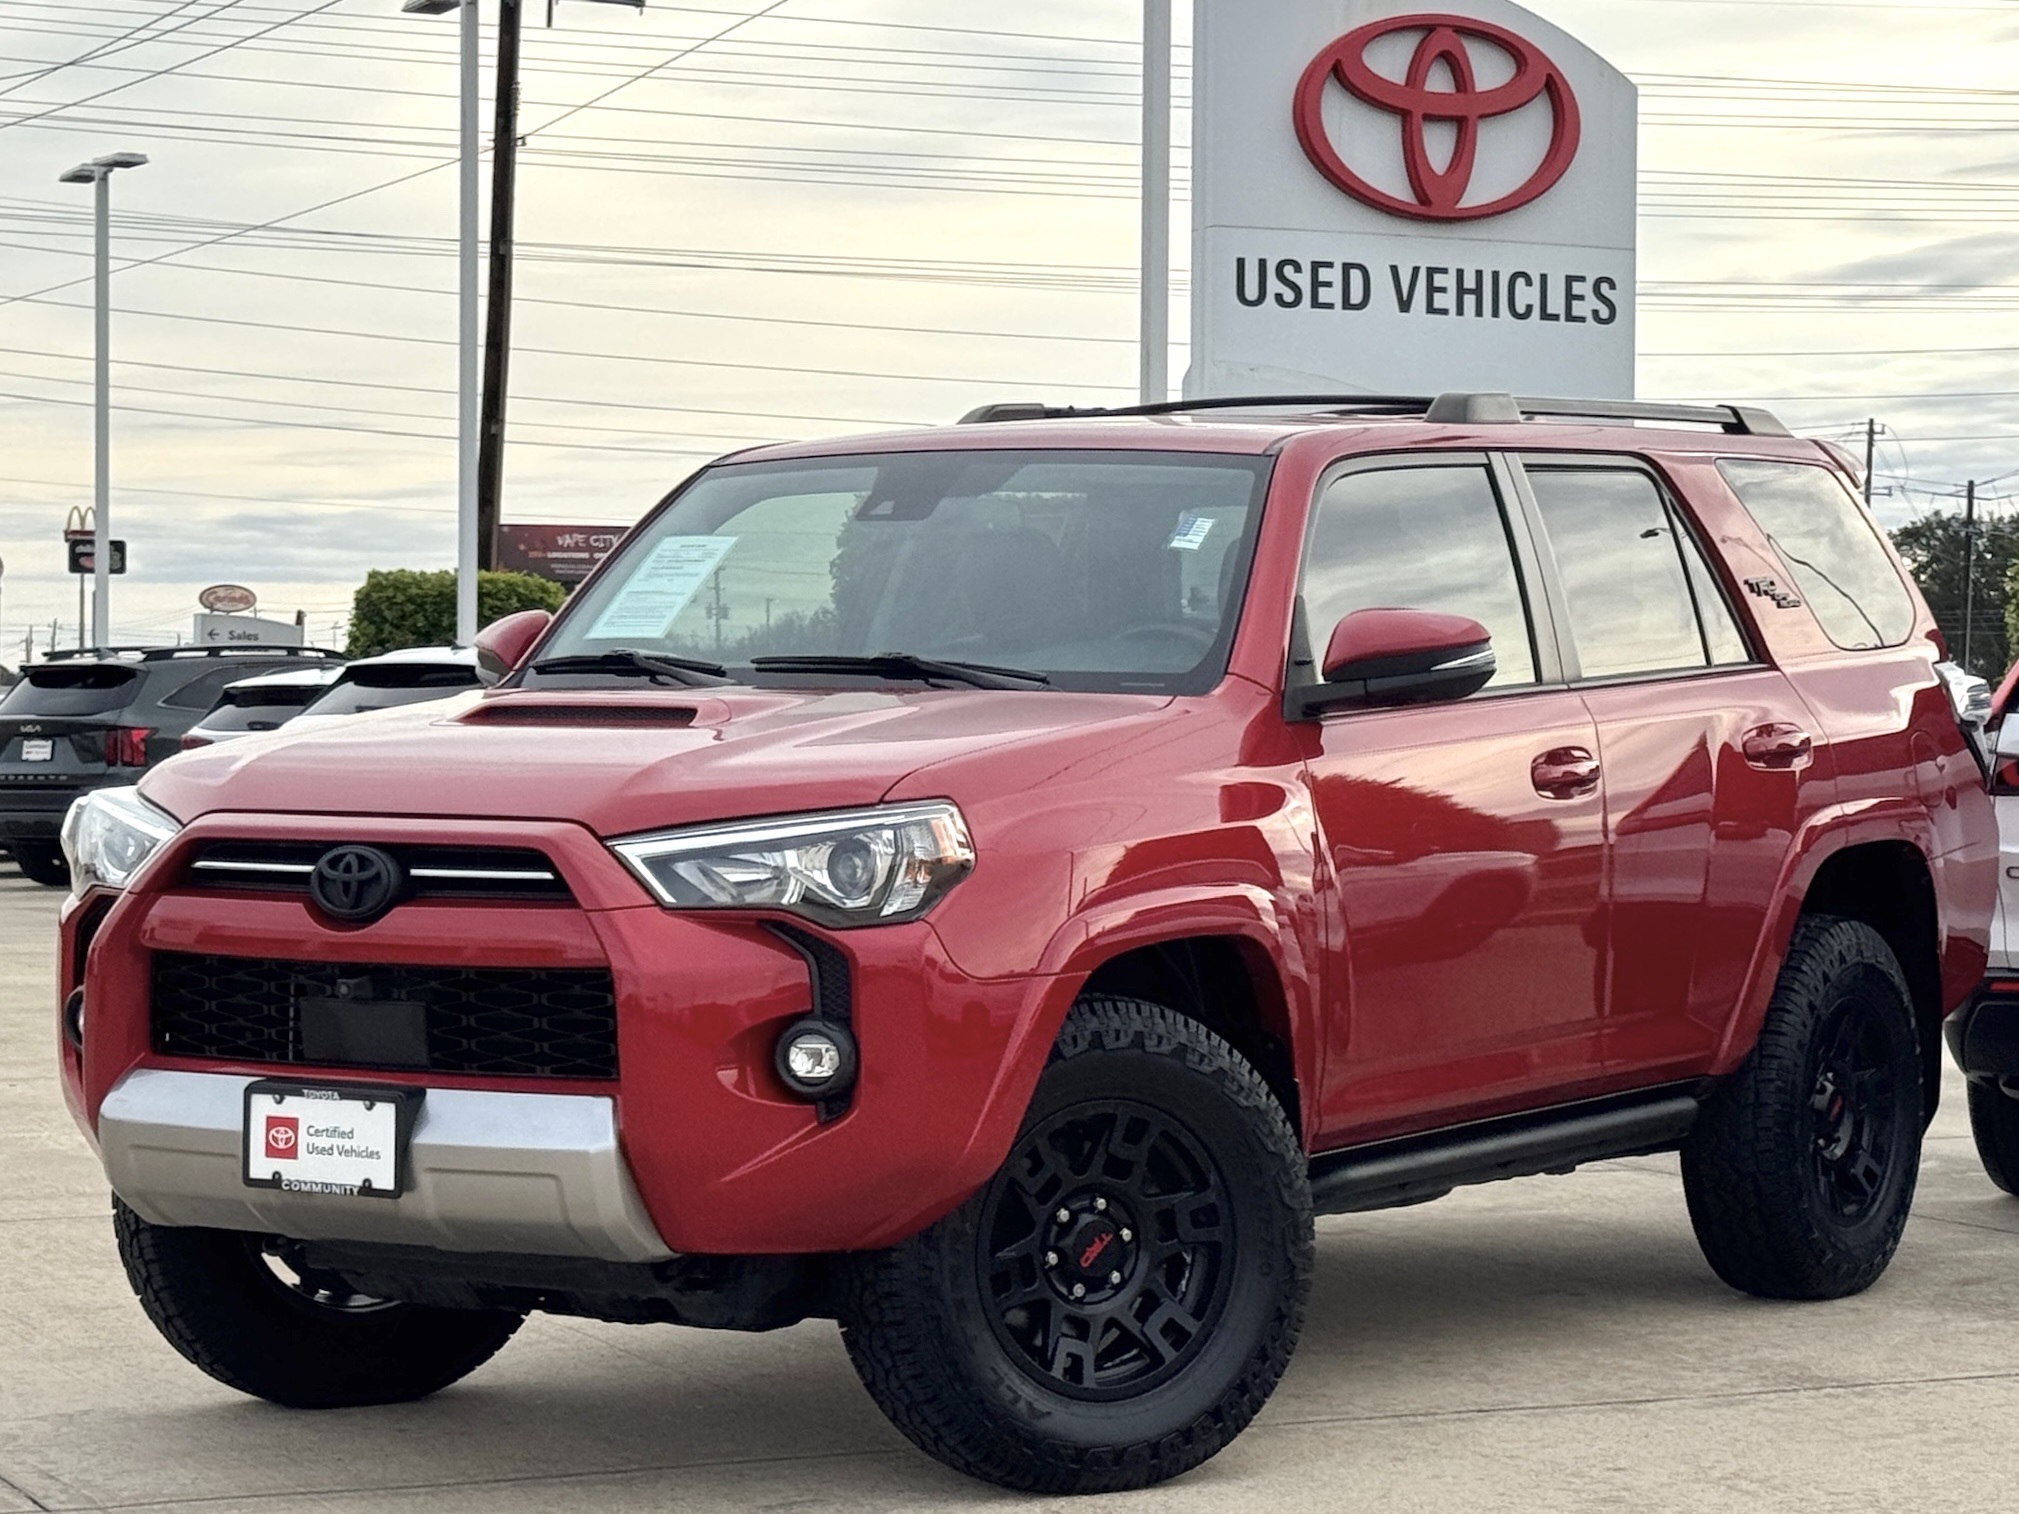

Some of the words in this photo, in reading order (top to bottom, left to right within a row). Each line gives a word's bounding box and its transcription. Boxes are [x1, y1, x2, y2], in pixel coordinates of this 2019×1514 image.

[1235, 256, 1372, 311] USED
[1389, 264, 1618, 325] VEHICLES
[556, 532, 588, 548] VAPE
[228, 629, 259, 641] Sales
[302, 1089, 341, 1101] TOYOTA
[306, 1125, 354, 1140] Certified
[306, 1143, 335, 1156] Used
[337, 1144, 381, 1160] Vehicles
[281, 1179, 361, 1196] COMMUNITY
